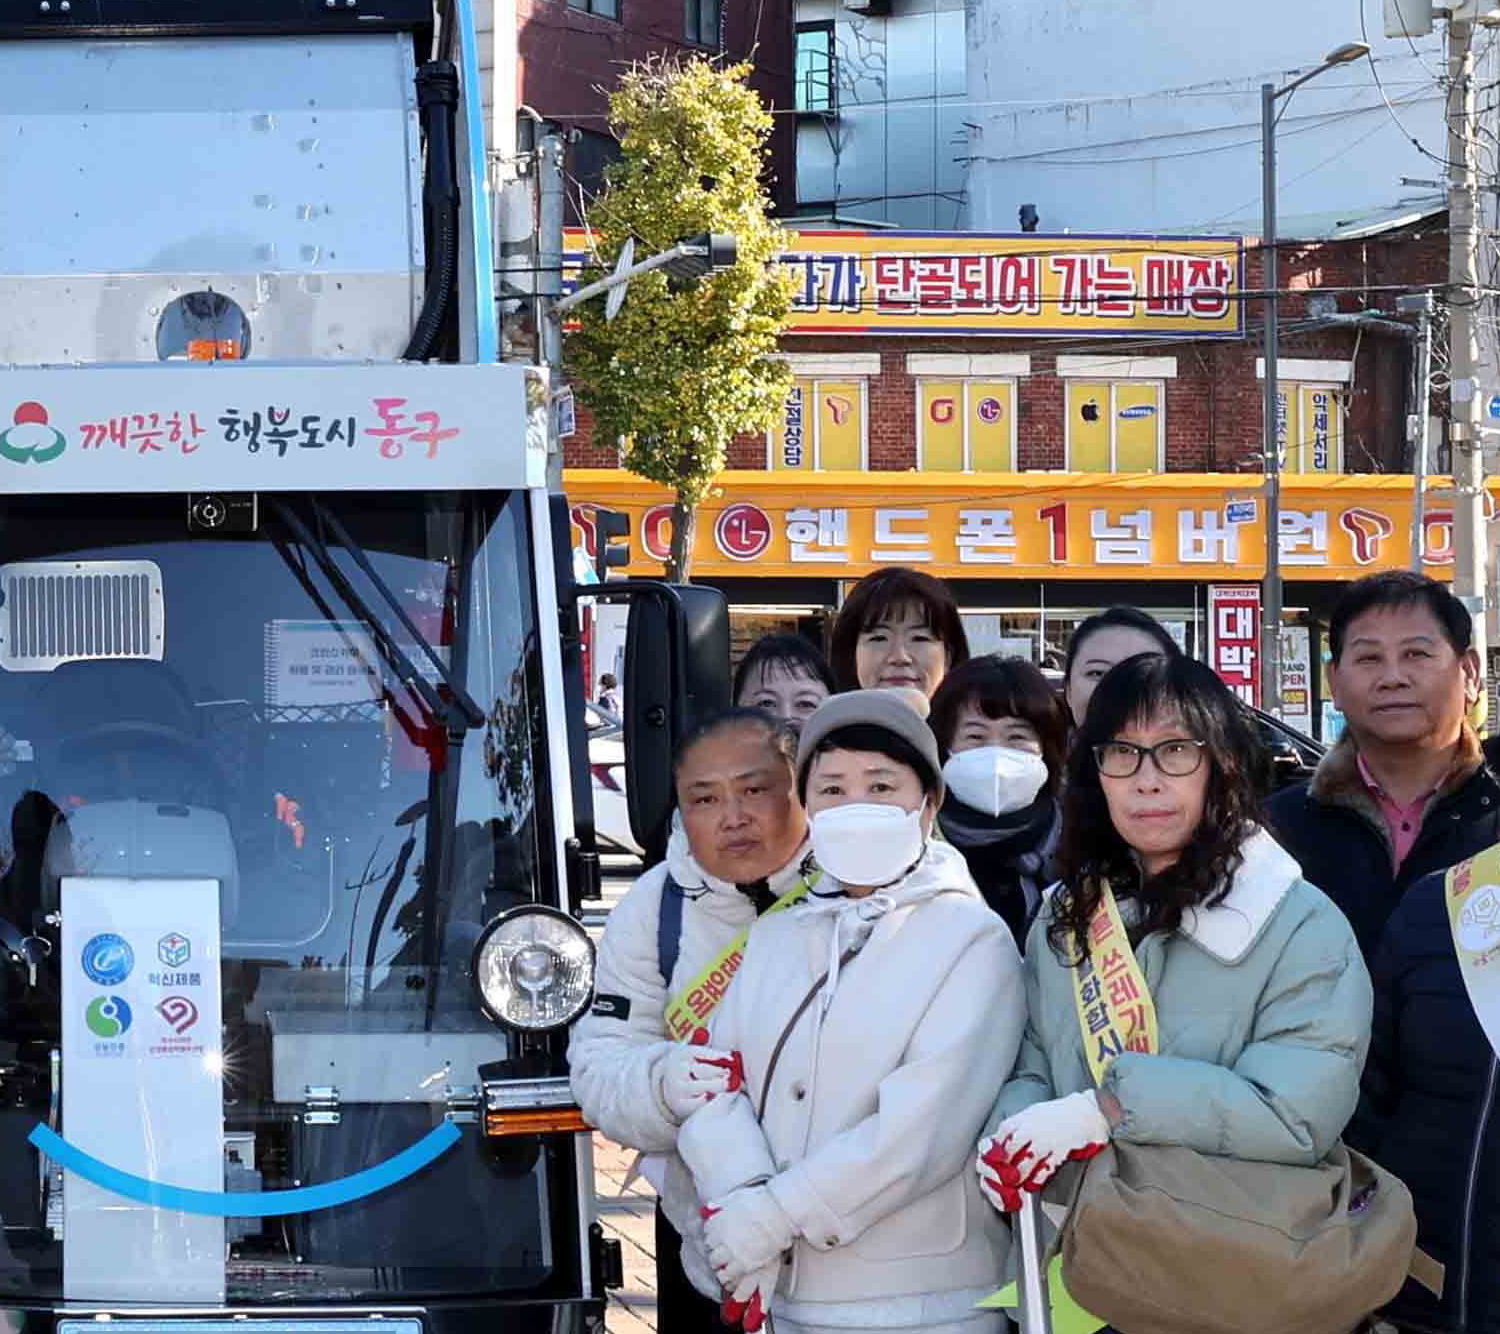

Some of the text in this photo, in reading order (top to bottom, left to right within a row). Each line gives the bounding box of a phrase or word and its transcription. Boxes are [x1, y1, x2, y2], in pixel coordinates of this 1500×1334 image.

[874, 256, 1040, 315] 단골되어
[1050, 258, 1133, 315] 가는
[1144, 258, 1232, 320] 매장
[80, 397, 460, 460] 깨끗한 행복도시 동구
